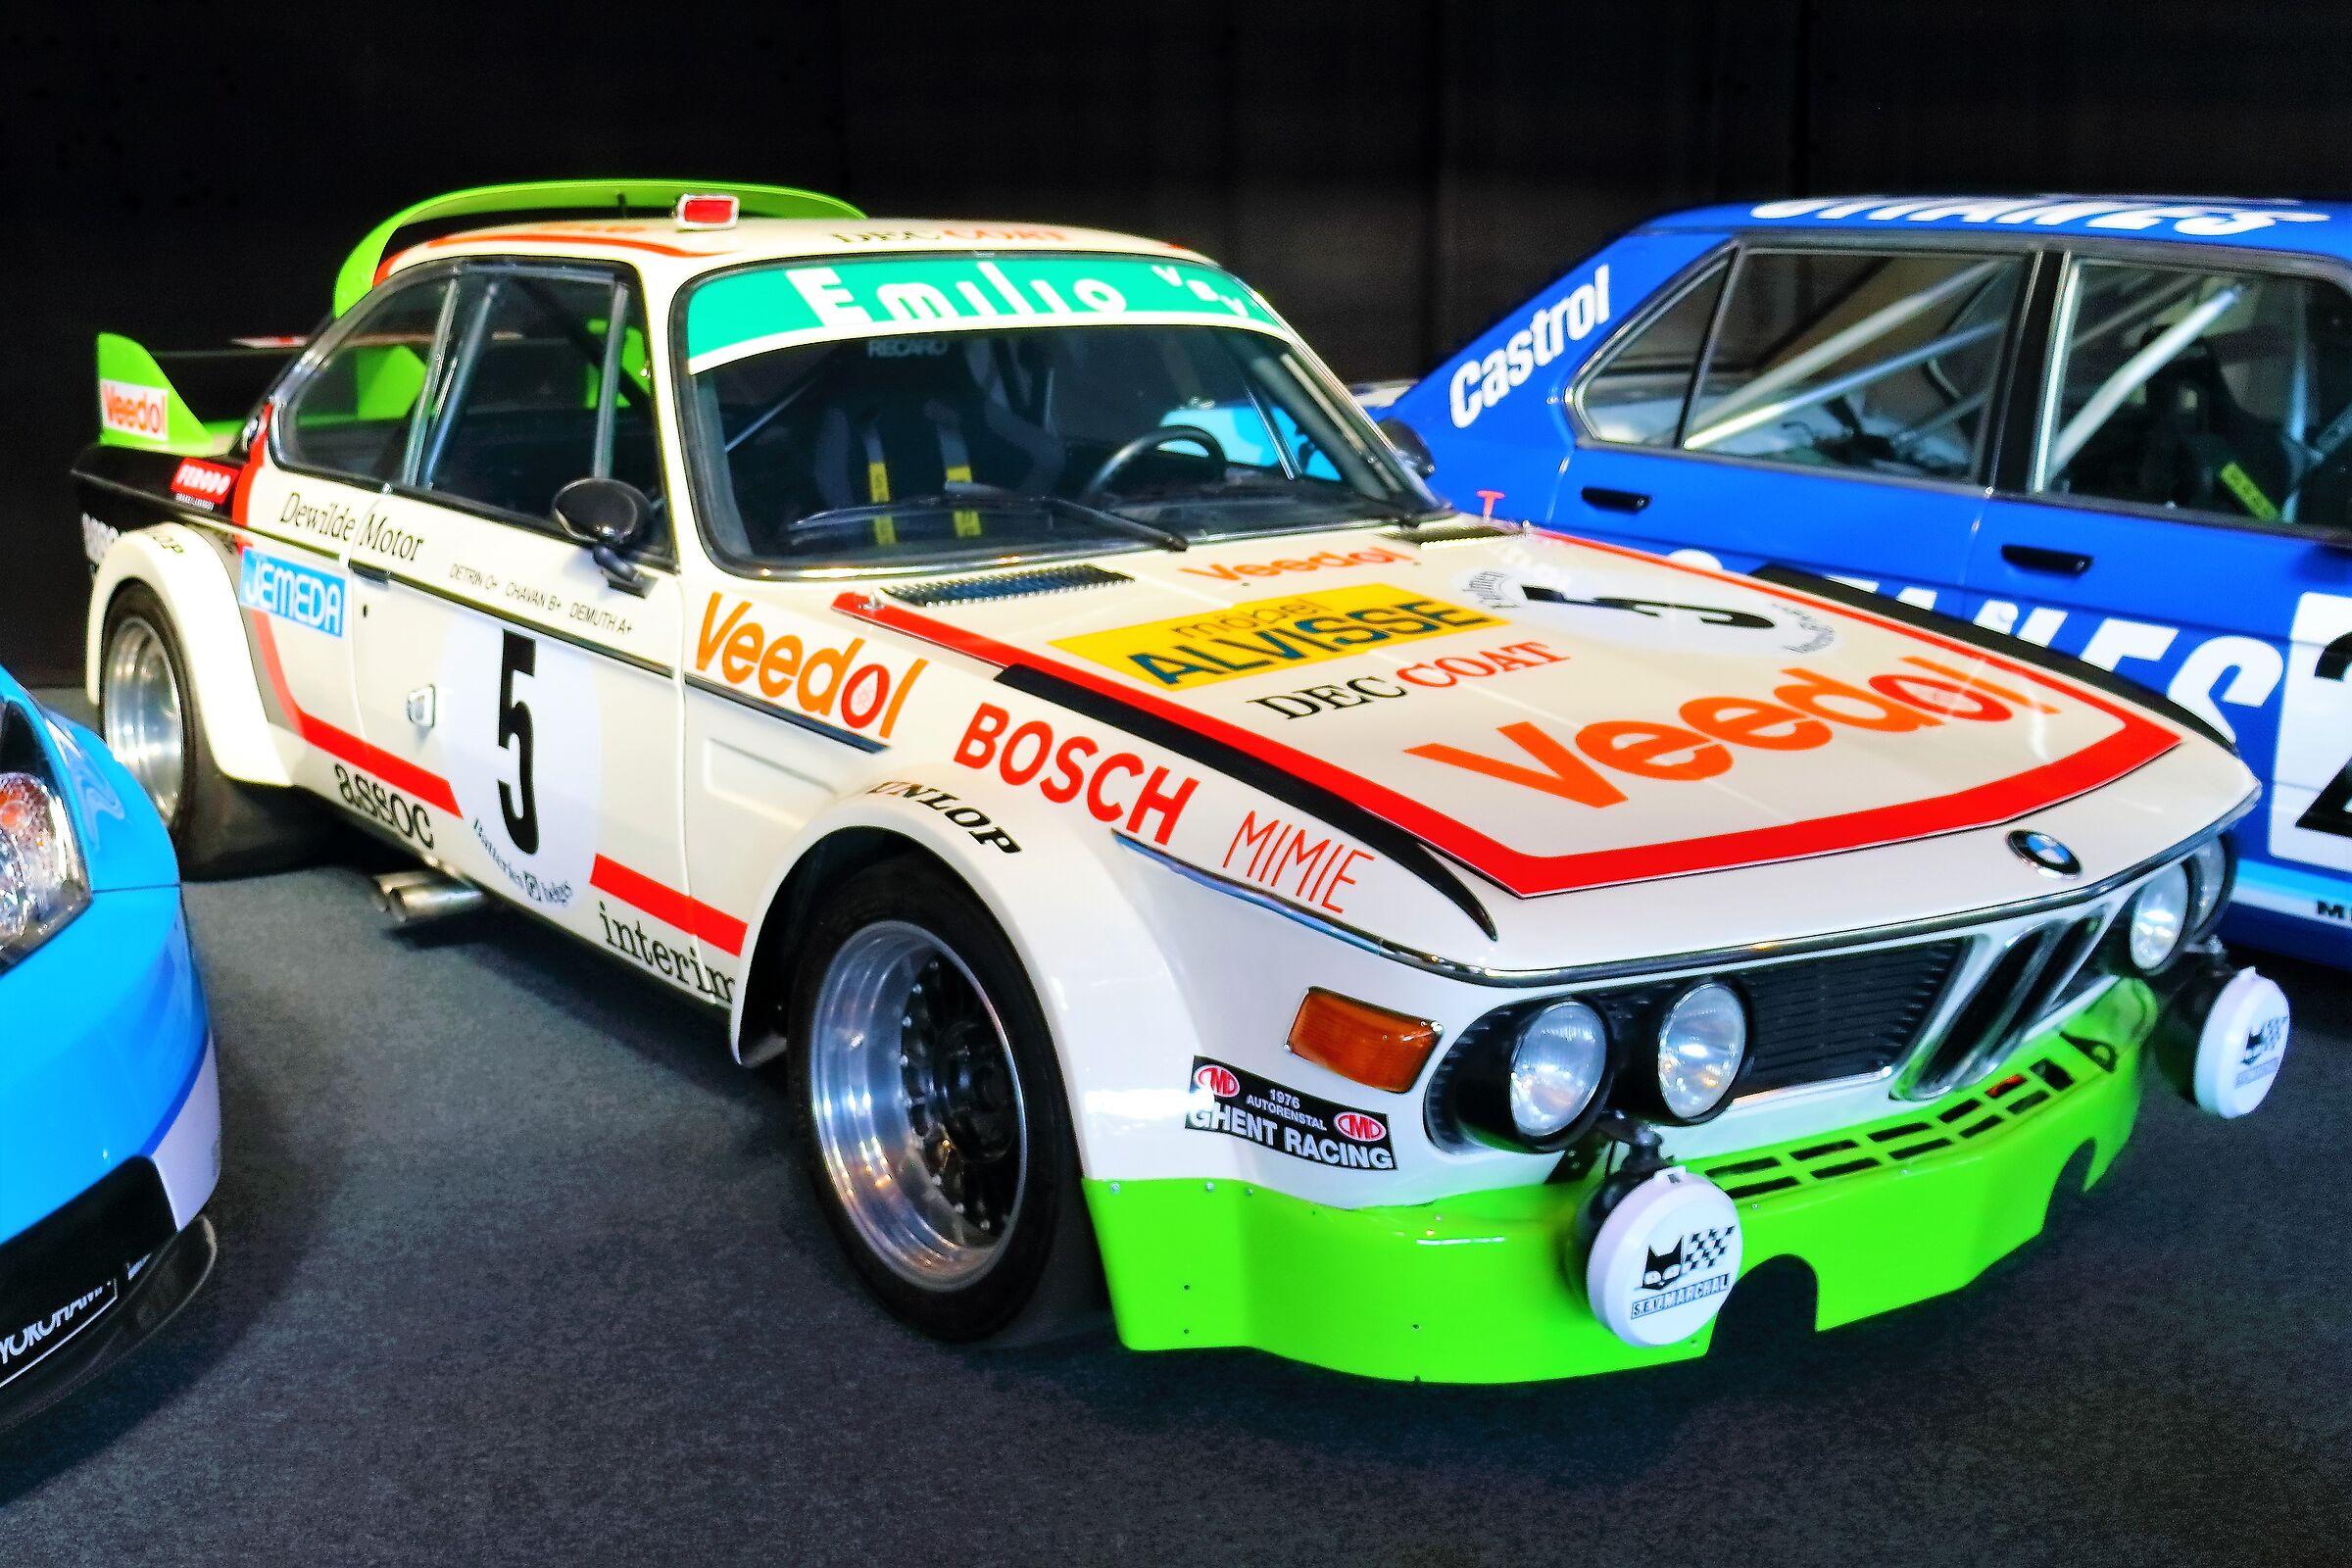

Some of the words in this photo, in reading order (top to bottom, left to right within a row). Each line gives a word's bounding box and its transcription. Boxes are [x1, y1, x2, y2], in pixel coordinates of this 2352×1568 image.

[785, 261, 1127, 327] Emilio
[1449, 265, 1609, 428] Castrol
[102, 382, 168, 435] Veedol
[359, 514, 424, 562] Motor
[1177, 547, 1413, 581] Veedol
[245, 557, 343, 634] JEMEDA
[696, 591, 930, 739] Veedol
[1128, 600, 1491, 685] ALVISSE
[1247, 675, 1408, 720] DEC
[1396, 640, 1573, 688] COAT
[497, 629, 539, 856] 5
[1402, 656, 2061, 808] Veedol
[954, 702, 1200, 847] BOSCH
[1223, 809, 1376, 914] MIMIE
[1188, 1101, 1278, 1147] GHENT
[1283, 1126, 1395, 1169] RACING
[1247, 1094, 1327, 1132] AUTORENSTAL
[1269, 1088, 1300, 1110] 1976
